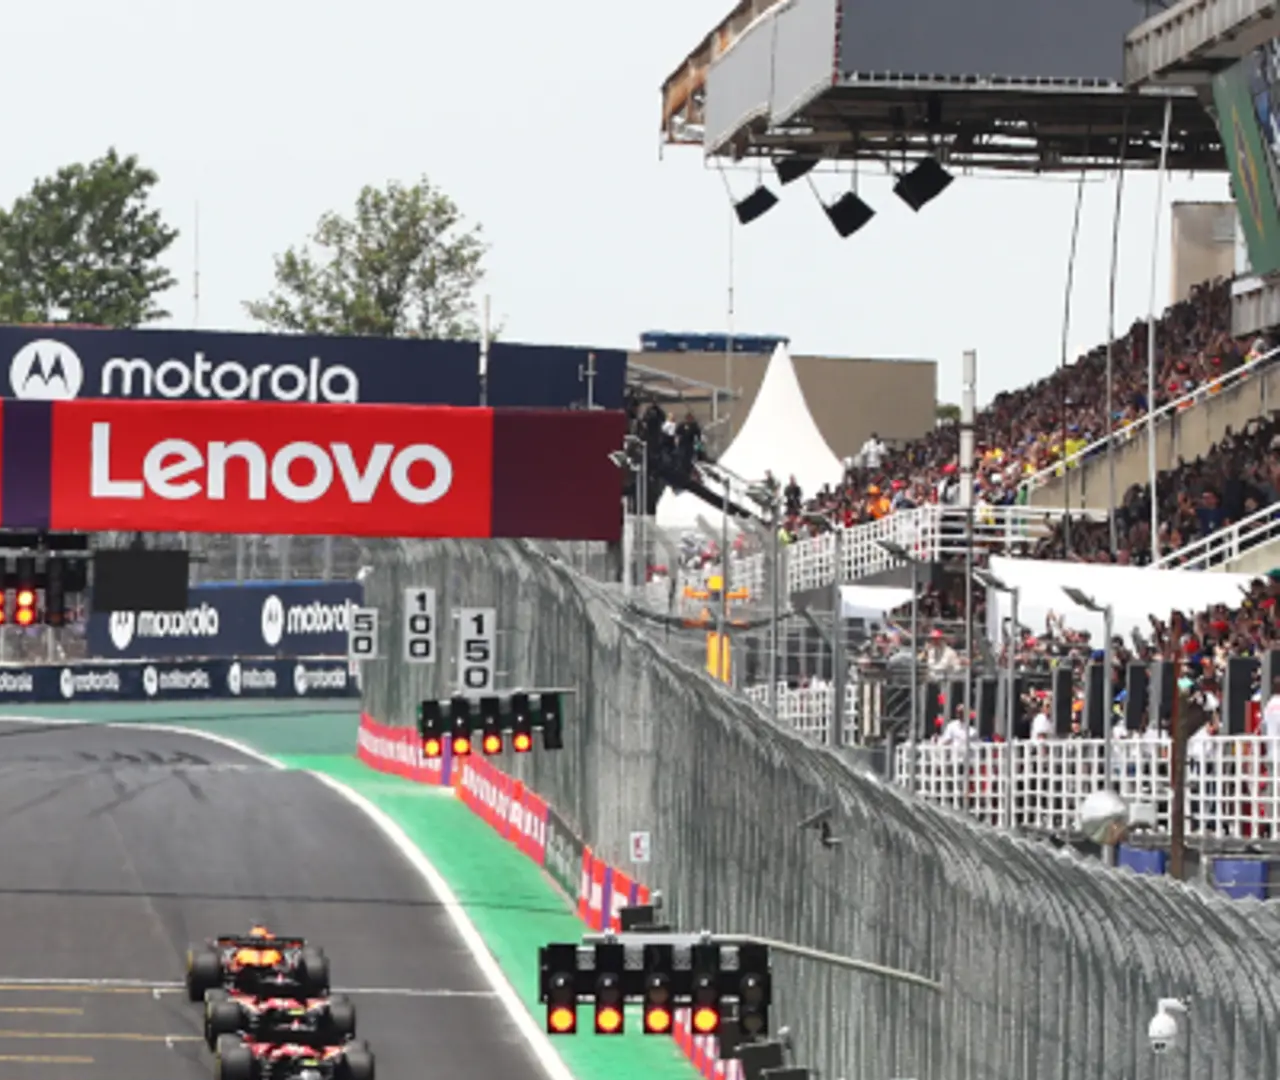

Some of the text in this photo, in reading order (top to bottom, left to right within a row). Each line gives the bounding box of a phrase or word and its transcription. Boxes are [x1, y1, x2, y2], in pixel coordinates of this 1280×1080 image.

[101, 352, 360, 403] motorola
[90, 422, 453, 504] Lenovo
[137, 603, 220, 636] motorola
[287, 599, 359, 634] motorol
